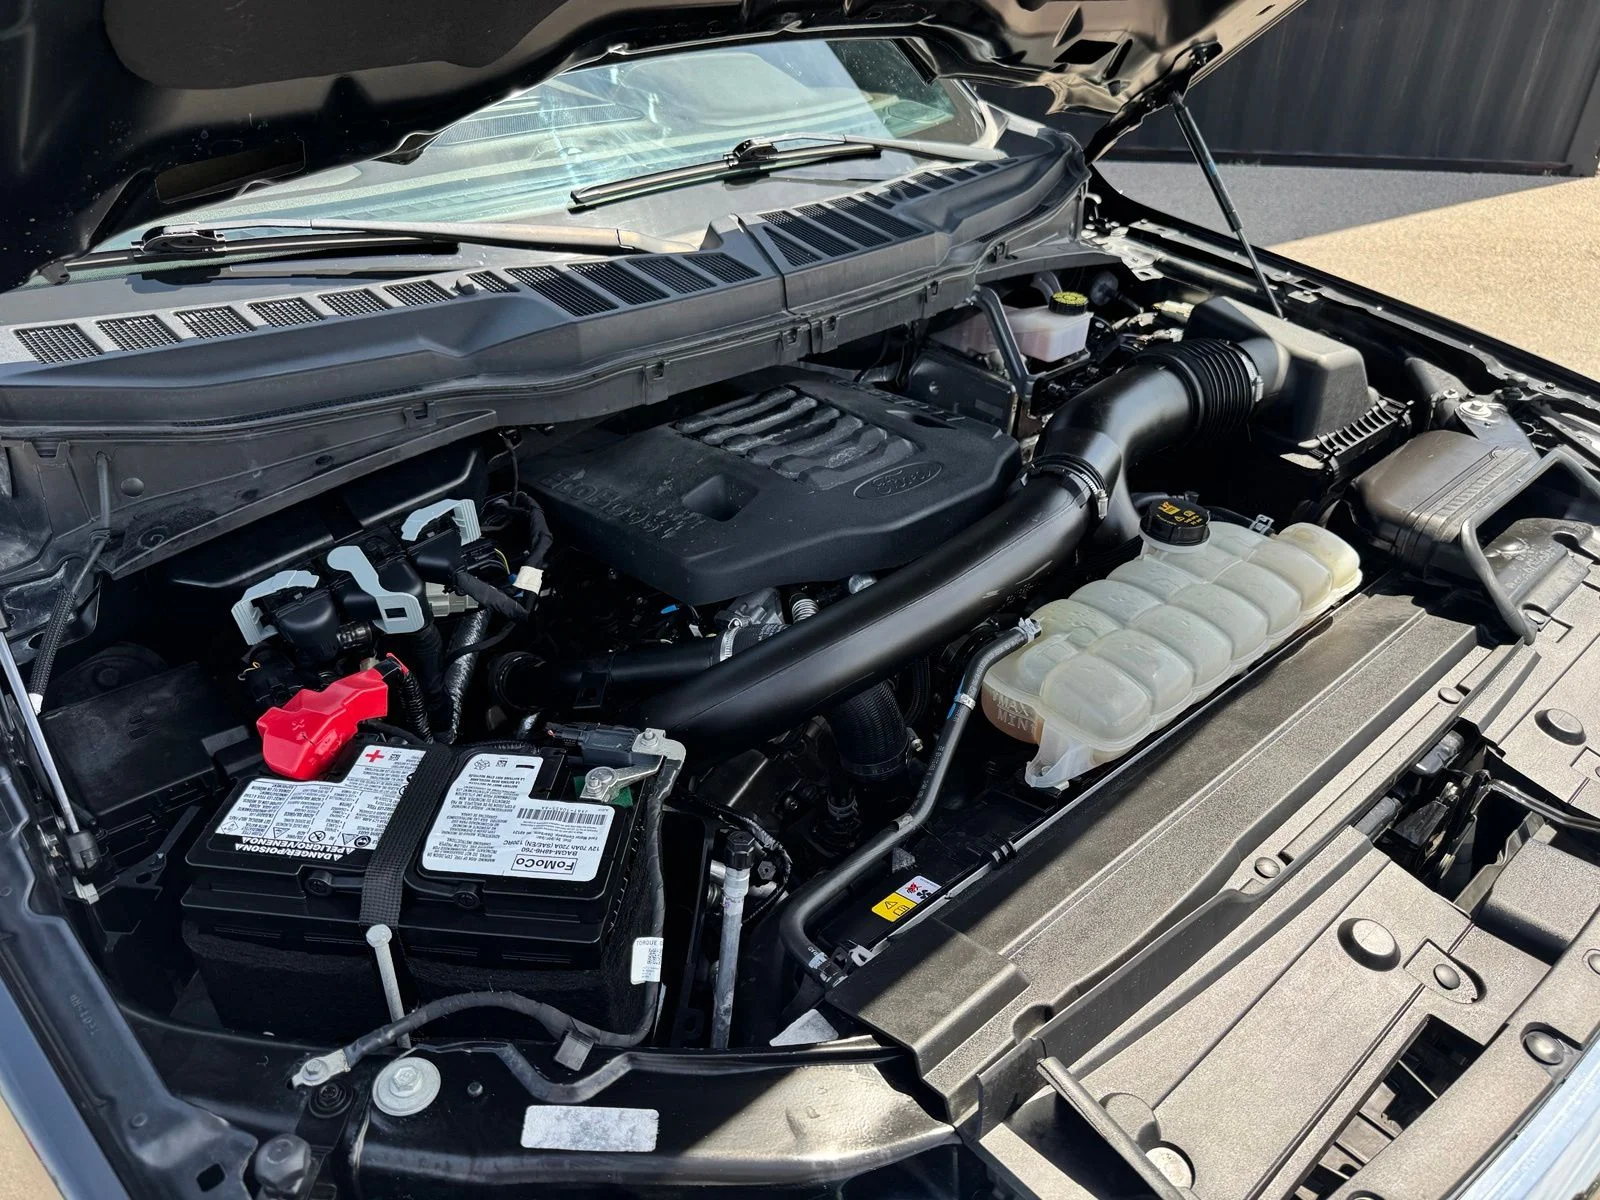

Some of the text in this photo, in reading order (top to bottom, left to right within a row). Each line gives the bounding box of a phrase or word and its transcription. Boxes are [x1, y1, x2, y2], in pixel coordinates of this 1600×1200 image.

[998, 694, 1029, 718] MAX
[997, 708, 1029, 732] MIN
[242, 843, 332, 859] DANGER/POISON
[247, 836, 346, 854] PELIGRO/VENENO
[516, 858, 574, 869] FoMoCo
